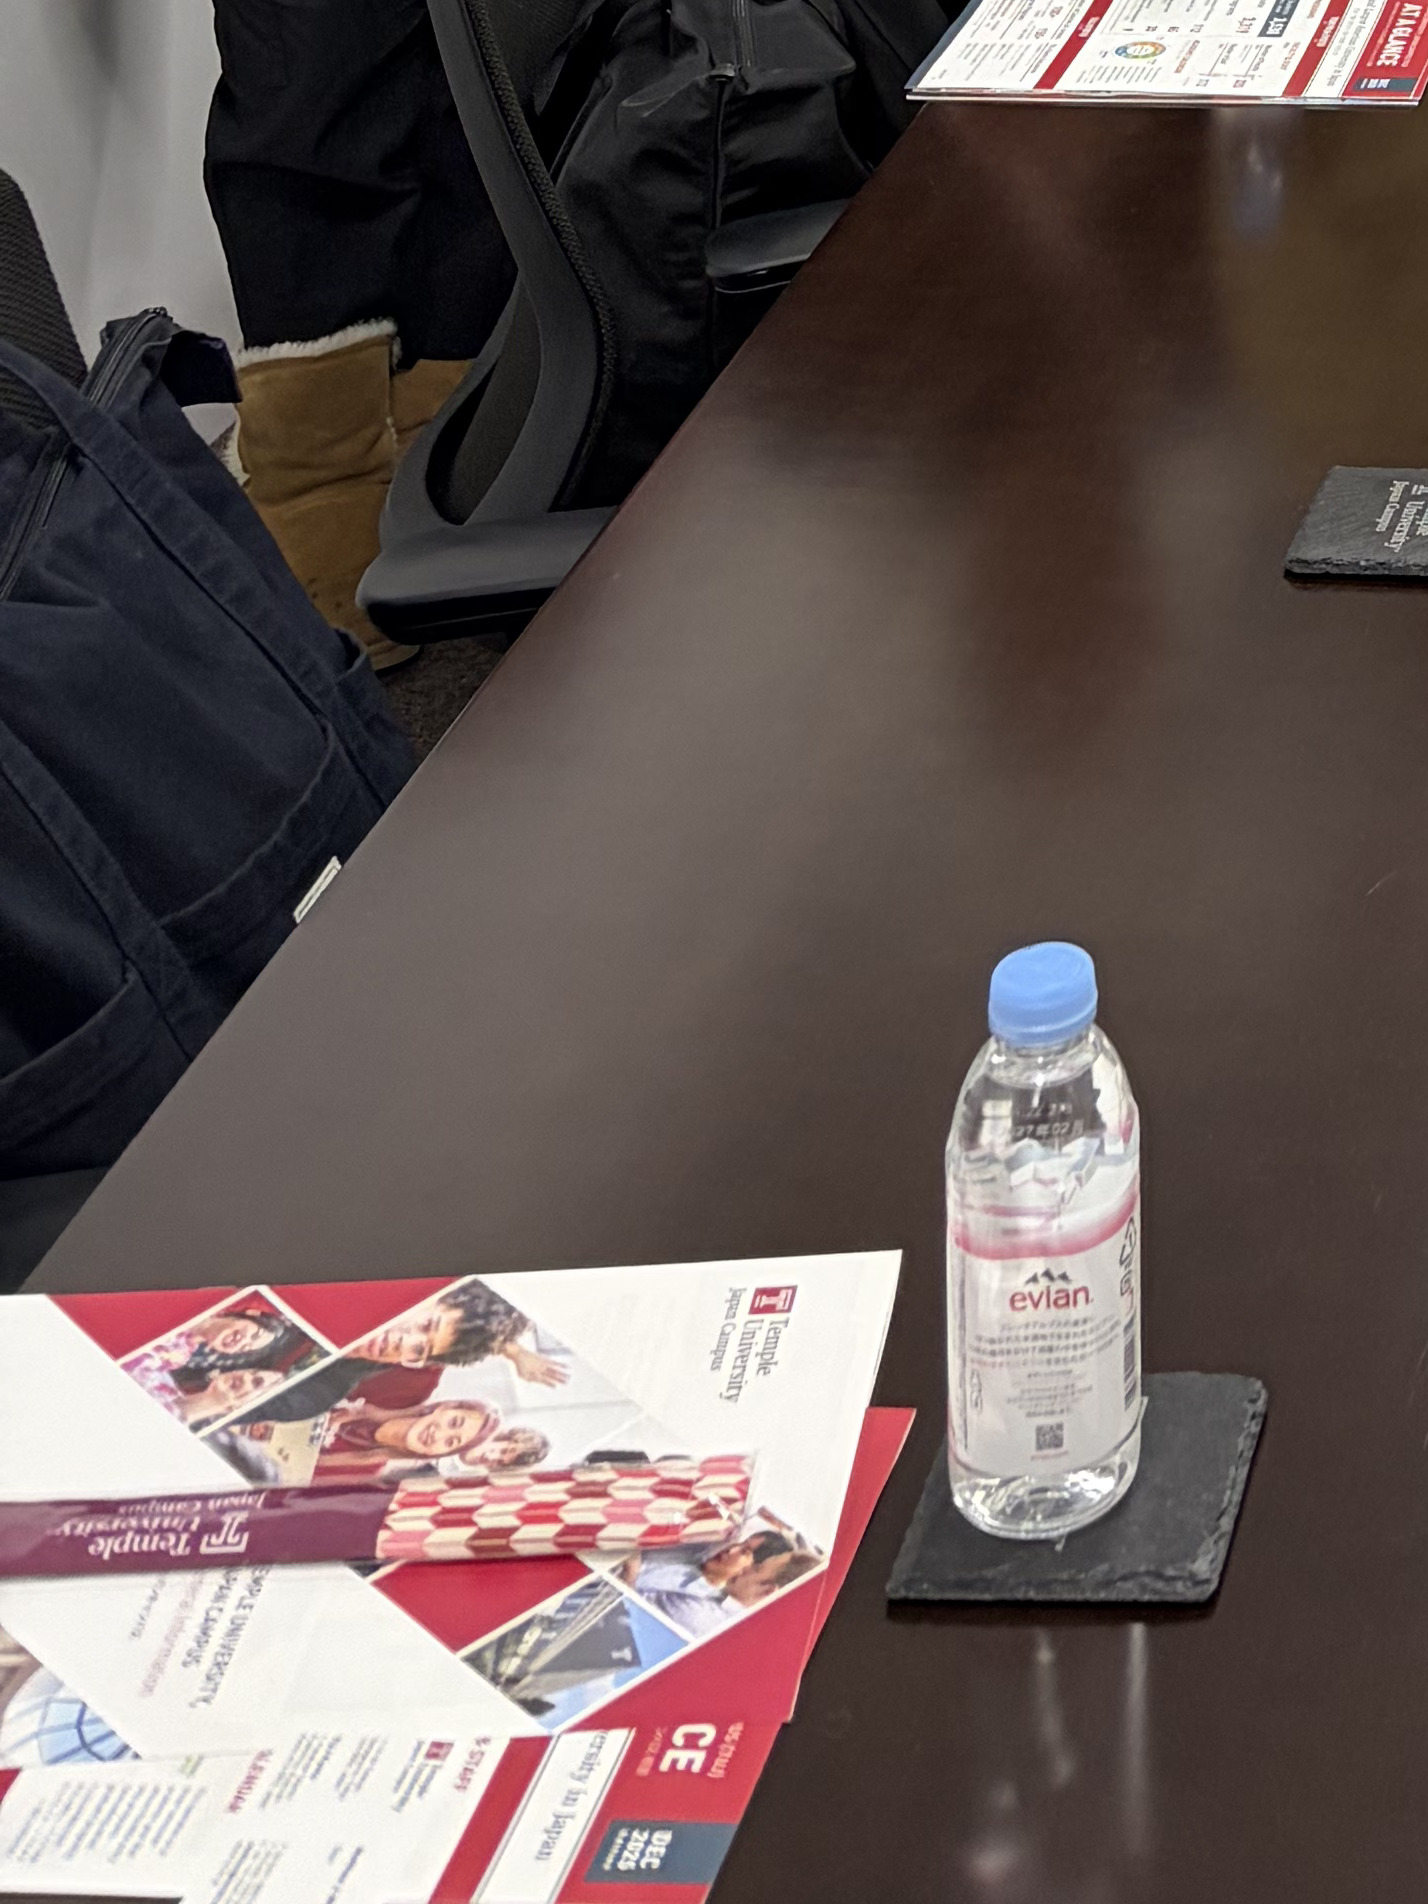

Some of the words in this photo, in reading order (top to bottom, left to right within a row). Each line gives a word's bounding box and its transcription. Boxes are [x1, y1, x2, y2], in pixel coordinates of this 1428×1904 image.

[1377, 26, 1413, 67] GLANCE
[1384, 501, 1425, 552] University
[725, 1287, 748, 1320] Japan
[1009, 1285, 1090, 1311] evian
[709, 1323, 737, 1371] Campus
[719, 1319, 765, 1403] University
[755, 1317, 790, 1376] Temple
[88, 1531, 191, 1560] Temple
[236, 1568, 271, 1611] EMPLE
[569, 1732, 608, 1784] ersity
[562, 1789, 588, 1807] in
[536, 1812, 576, 1861] Japan
[640, 1829, 673, 1869] DEC
